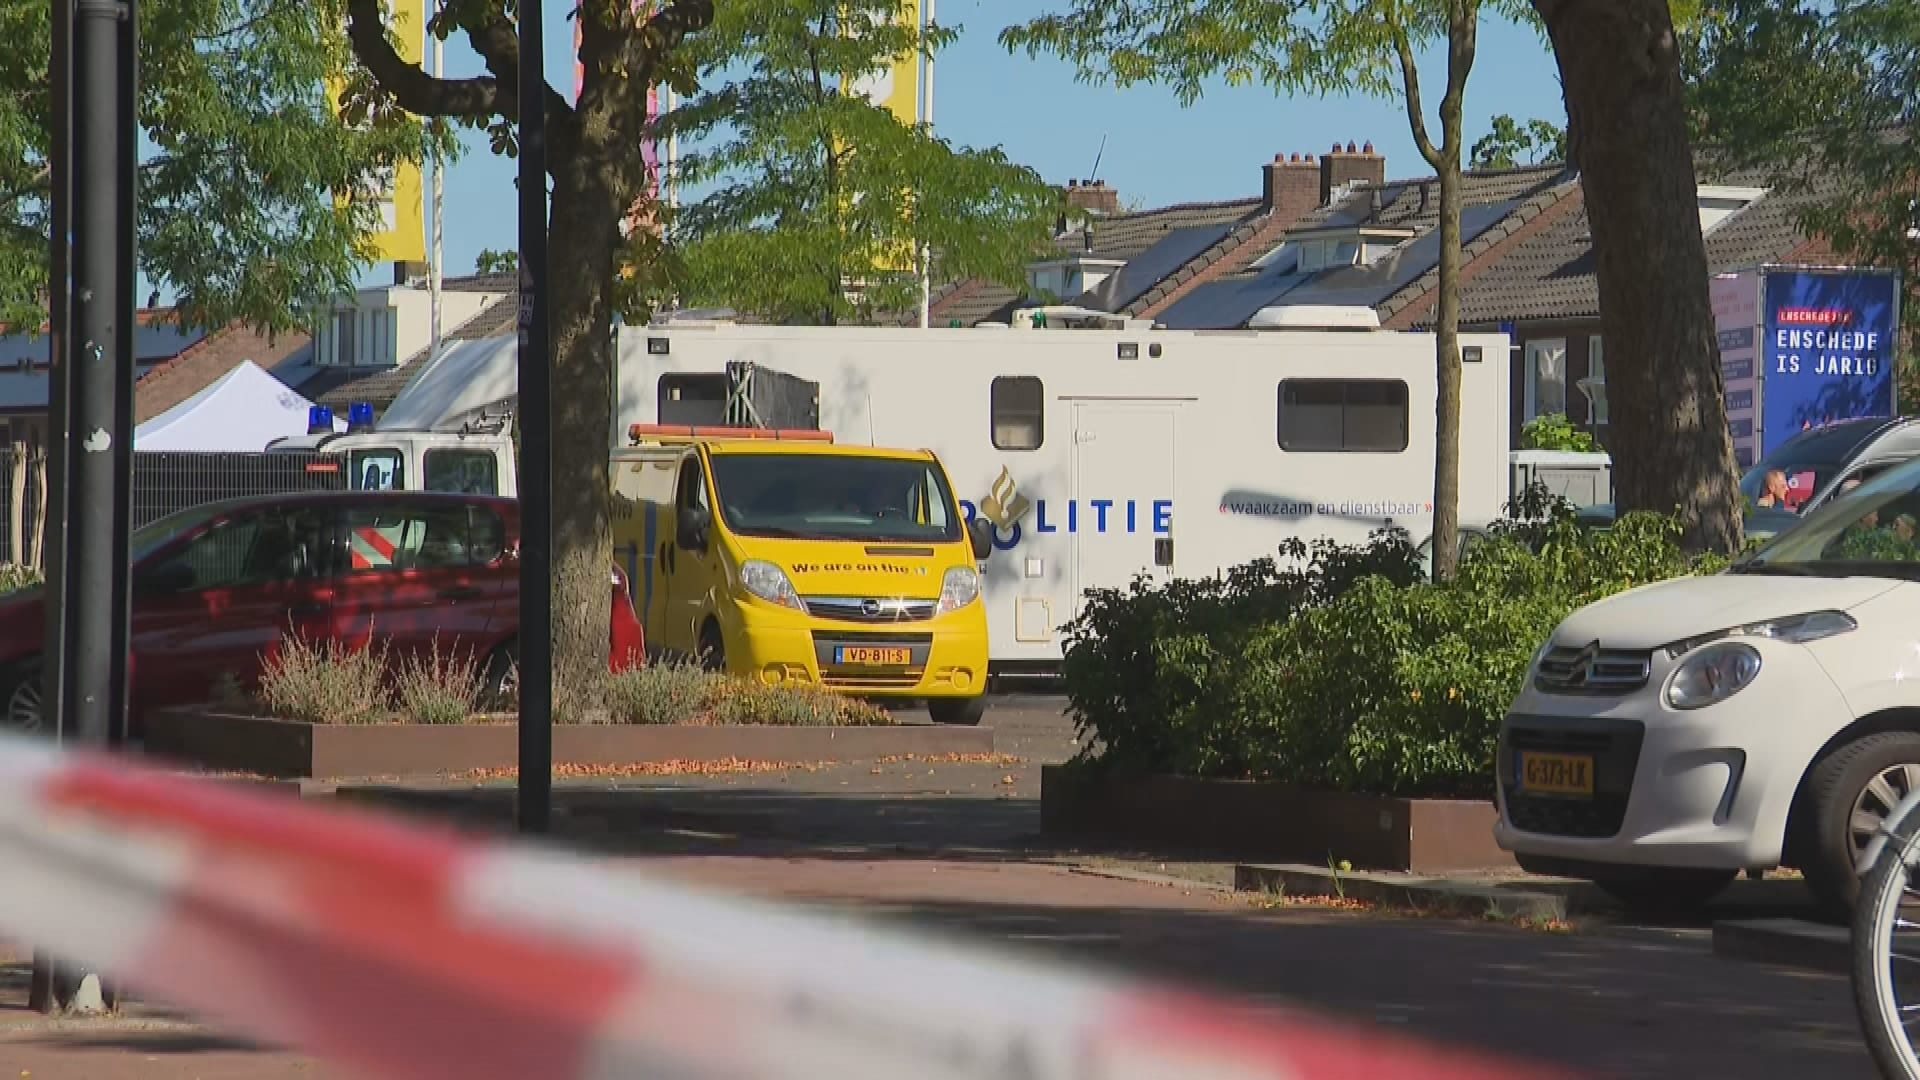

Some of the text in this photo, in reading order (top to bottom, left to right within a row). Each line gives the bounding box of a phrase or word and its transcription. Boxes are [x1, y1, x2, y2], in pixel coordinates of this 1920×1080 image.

[1777, 329, 1878, 350] ENSCHEDE
[1777, 354, 1878, 375] IS JARIG
[1231, 501, 1312, 515] waakzaam
[1317, 502, 1335, 514] en
[1340, 500, 1419, 515] dienstbaar
[792, 563, 819, 573] We
[824, 563, 852, 571] are
[856, 563, 878, 571] on
[881, 563, 909, 574] the
